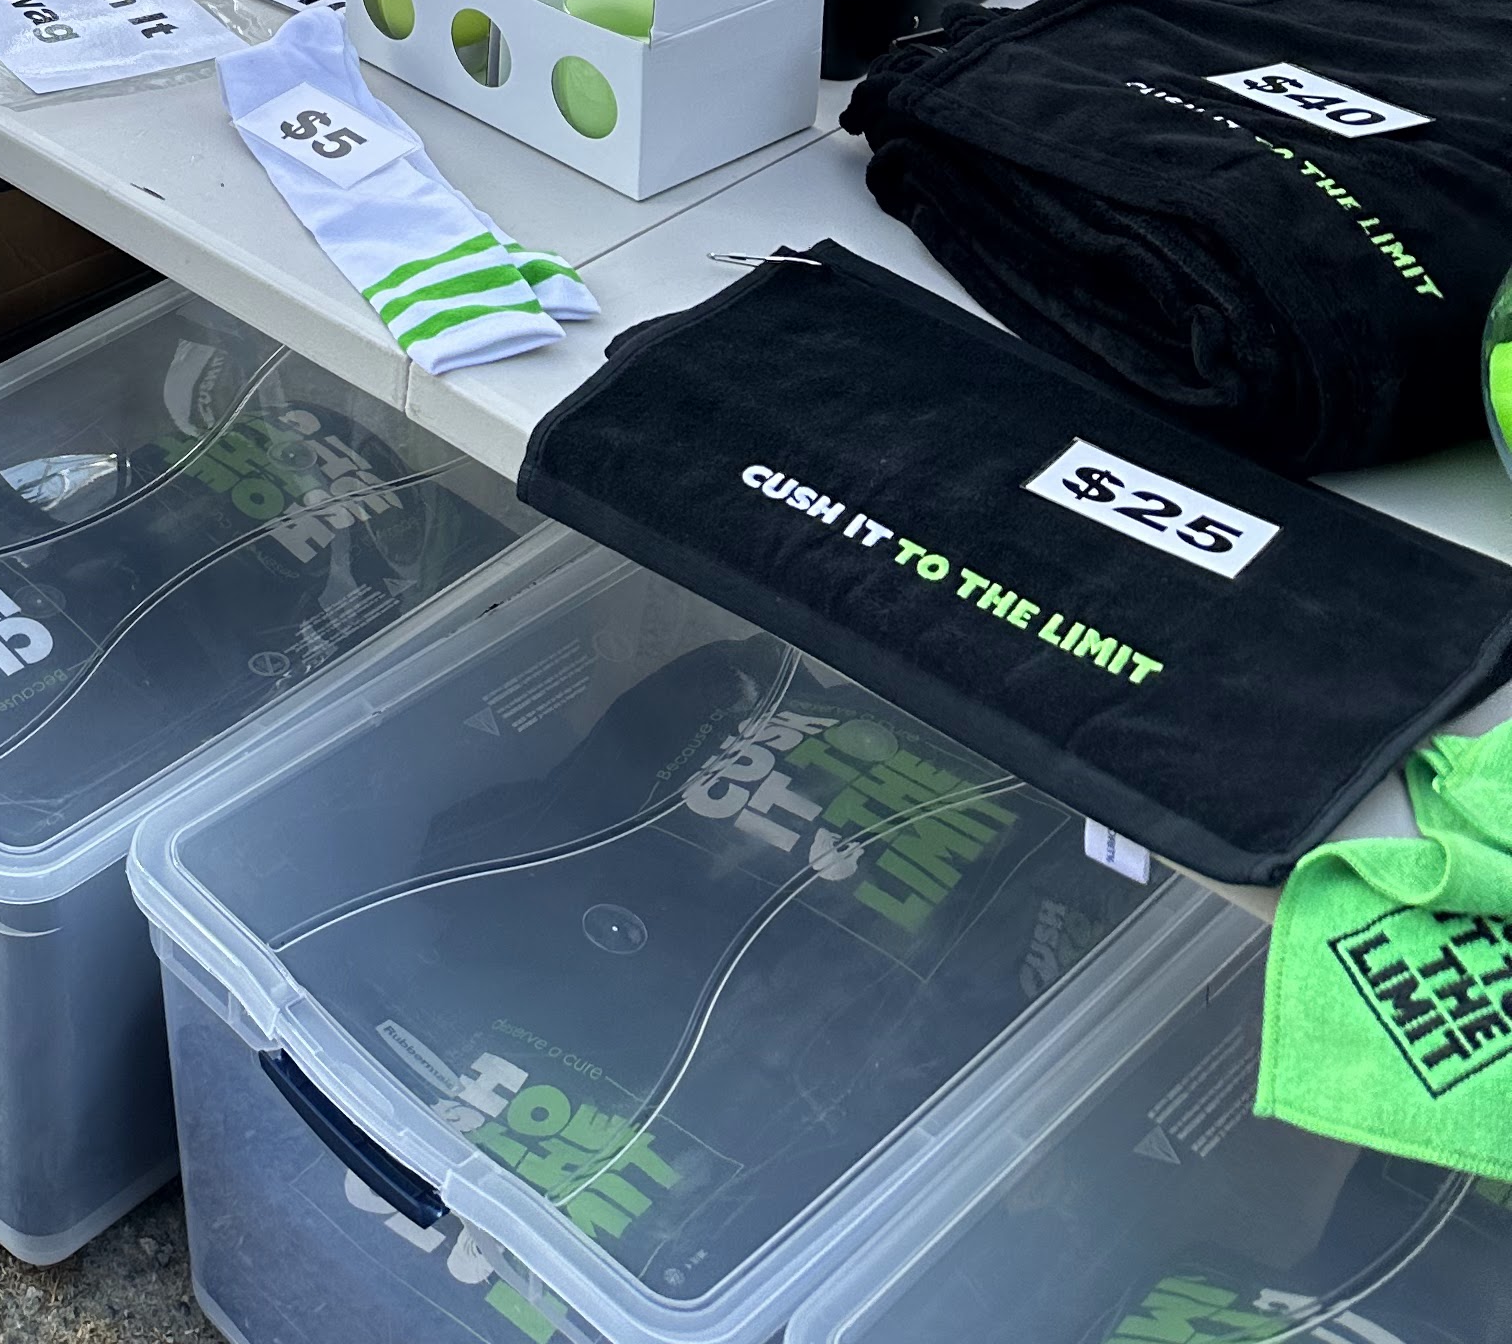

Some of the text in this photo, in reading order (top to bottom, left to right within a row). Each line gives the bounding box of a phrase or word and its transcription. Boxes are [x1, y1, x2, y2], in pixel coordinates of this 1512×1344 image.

[128, 12, 180, 40] It
[280, 110, 368, 160] $5
[1243, 75, 1386, 126] $40
[1062, 465, 1244, 555] $25
[741, 463, 1165, 686] CUSH IT TO THE LIMIT
[733, 770, 823, 853] IT
[1347, 930, 1473, 1071] LIMIT
[1417, 945, 1512, 1051] THE
[491, 1017, 604, 1081] deserve a cure
